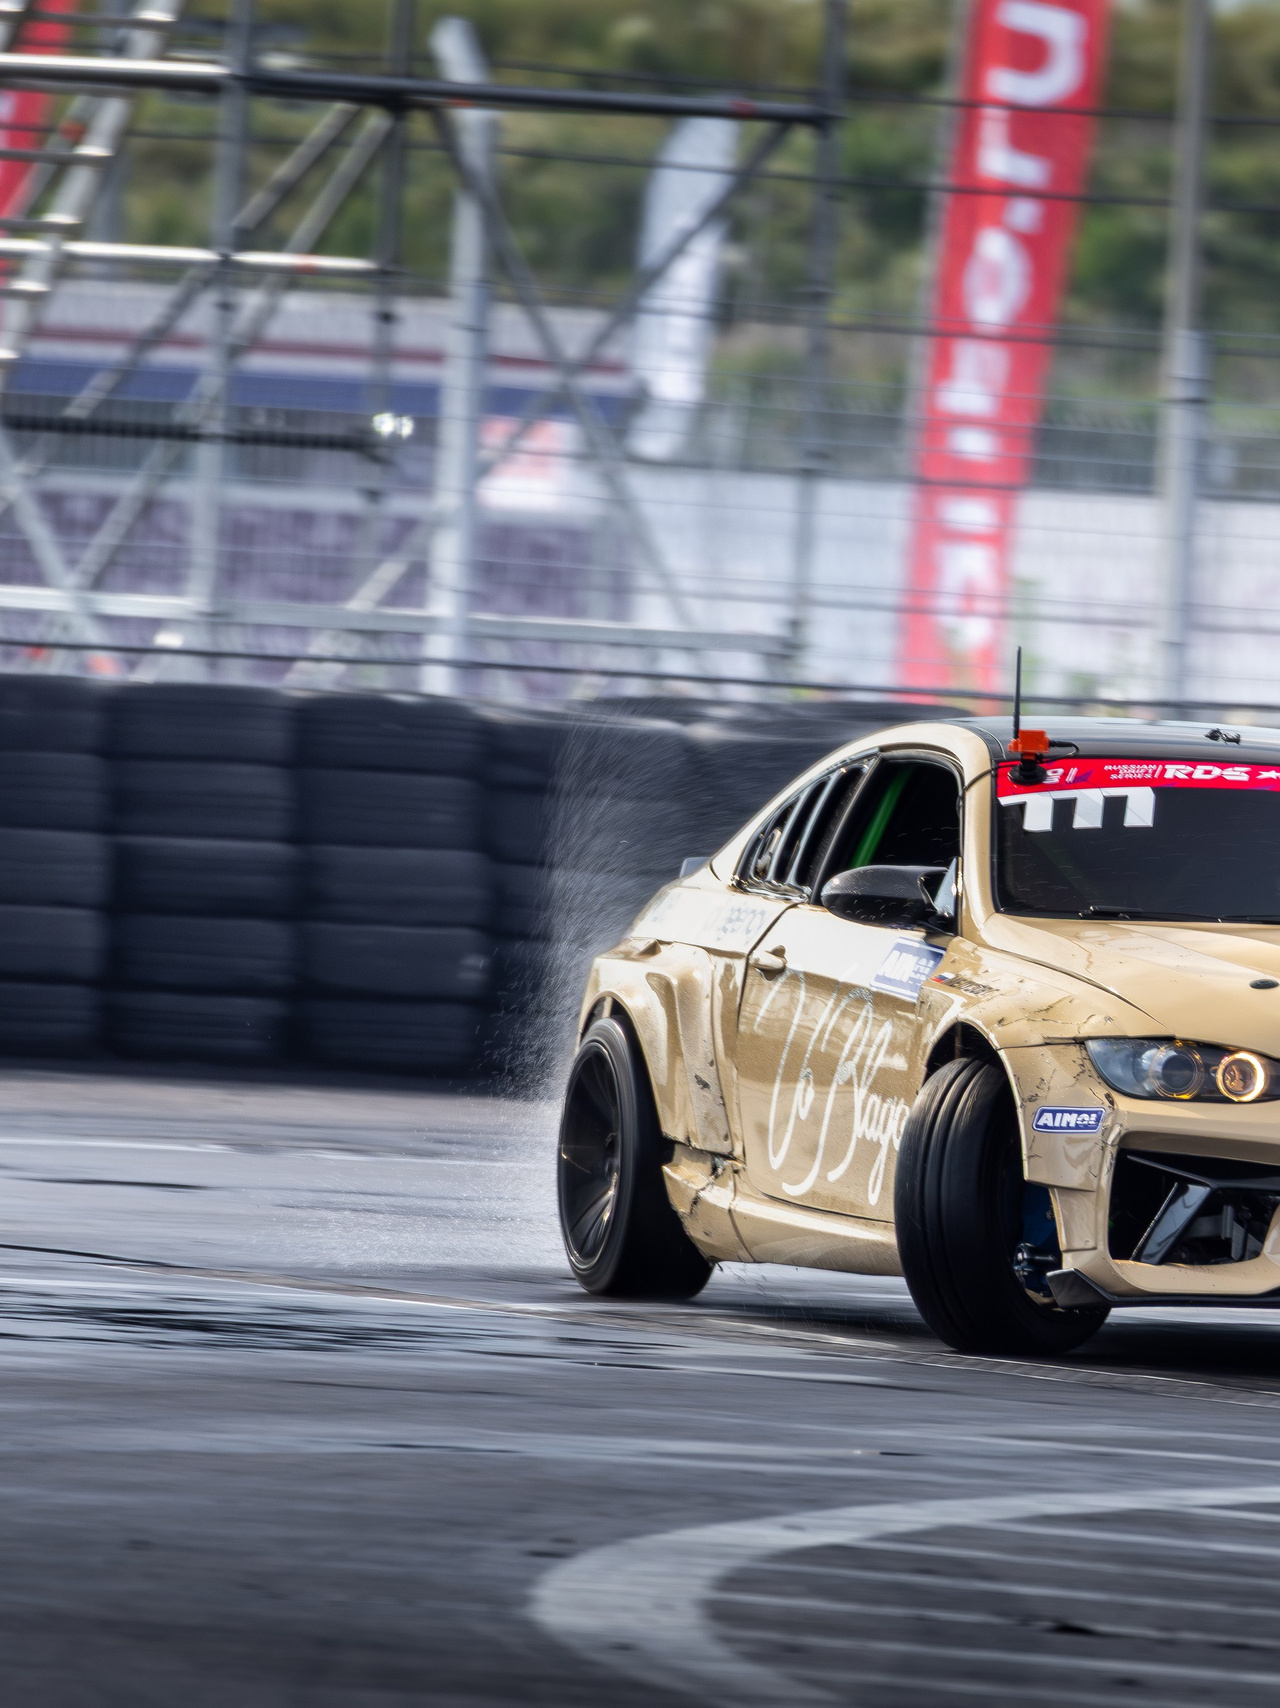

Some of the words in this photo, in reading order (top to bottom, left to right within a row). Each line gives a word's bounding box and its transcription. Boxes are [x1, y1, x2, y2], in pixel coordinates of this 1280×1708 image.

[1103, 763, 1158, 772] RUSSIAN
[1163, 764, 1252, 782] RDS
[1109, 773, 1153, 781] SERIES
[1037, 1112, 1098, 1128] AIMOL
